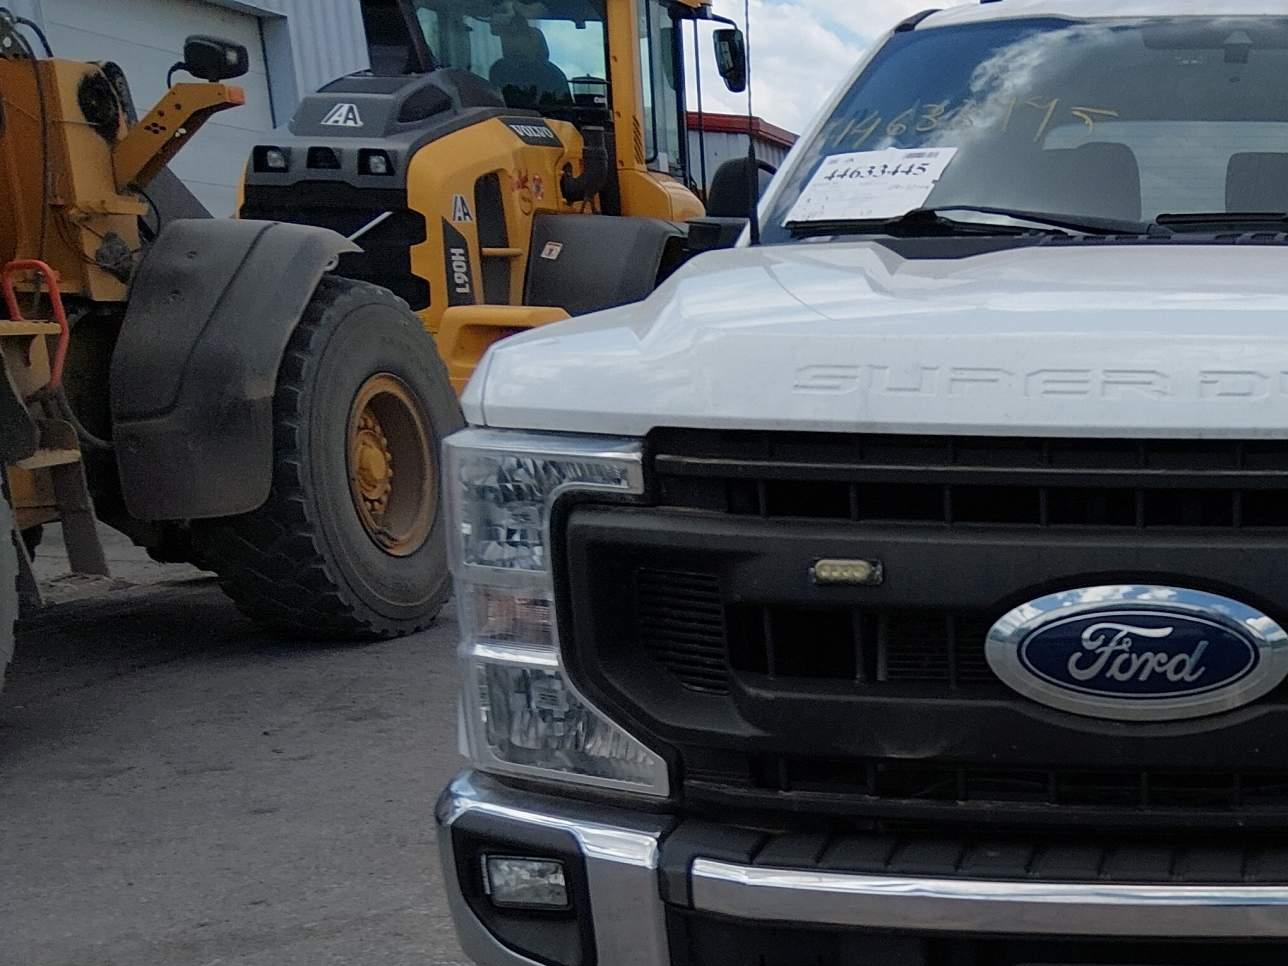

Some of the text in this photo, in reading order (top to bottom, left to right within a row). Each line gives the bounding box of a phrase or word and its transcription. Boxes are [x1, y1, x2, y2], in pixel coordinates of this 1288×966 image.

[509, 124, 555, 139] VOLVO
[824, 162, 930, 181] 44633445
[449, 248, 471, 294] L90H
[792, 363, 1174, 399] SUPER
[1068, 622, 1210, 682] Ford
